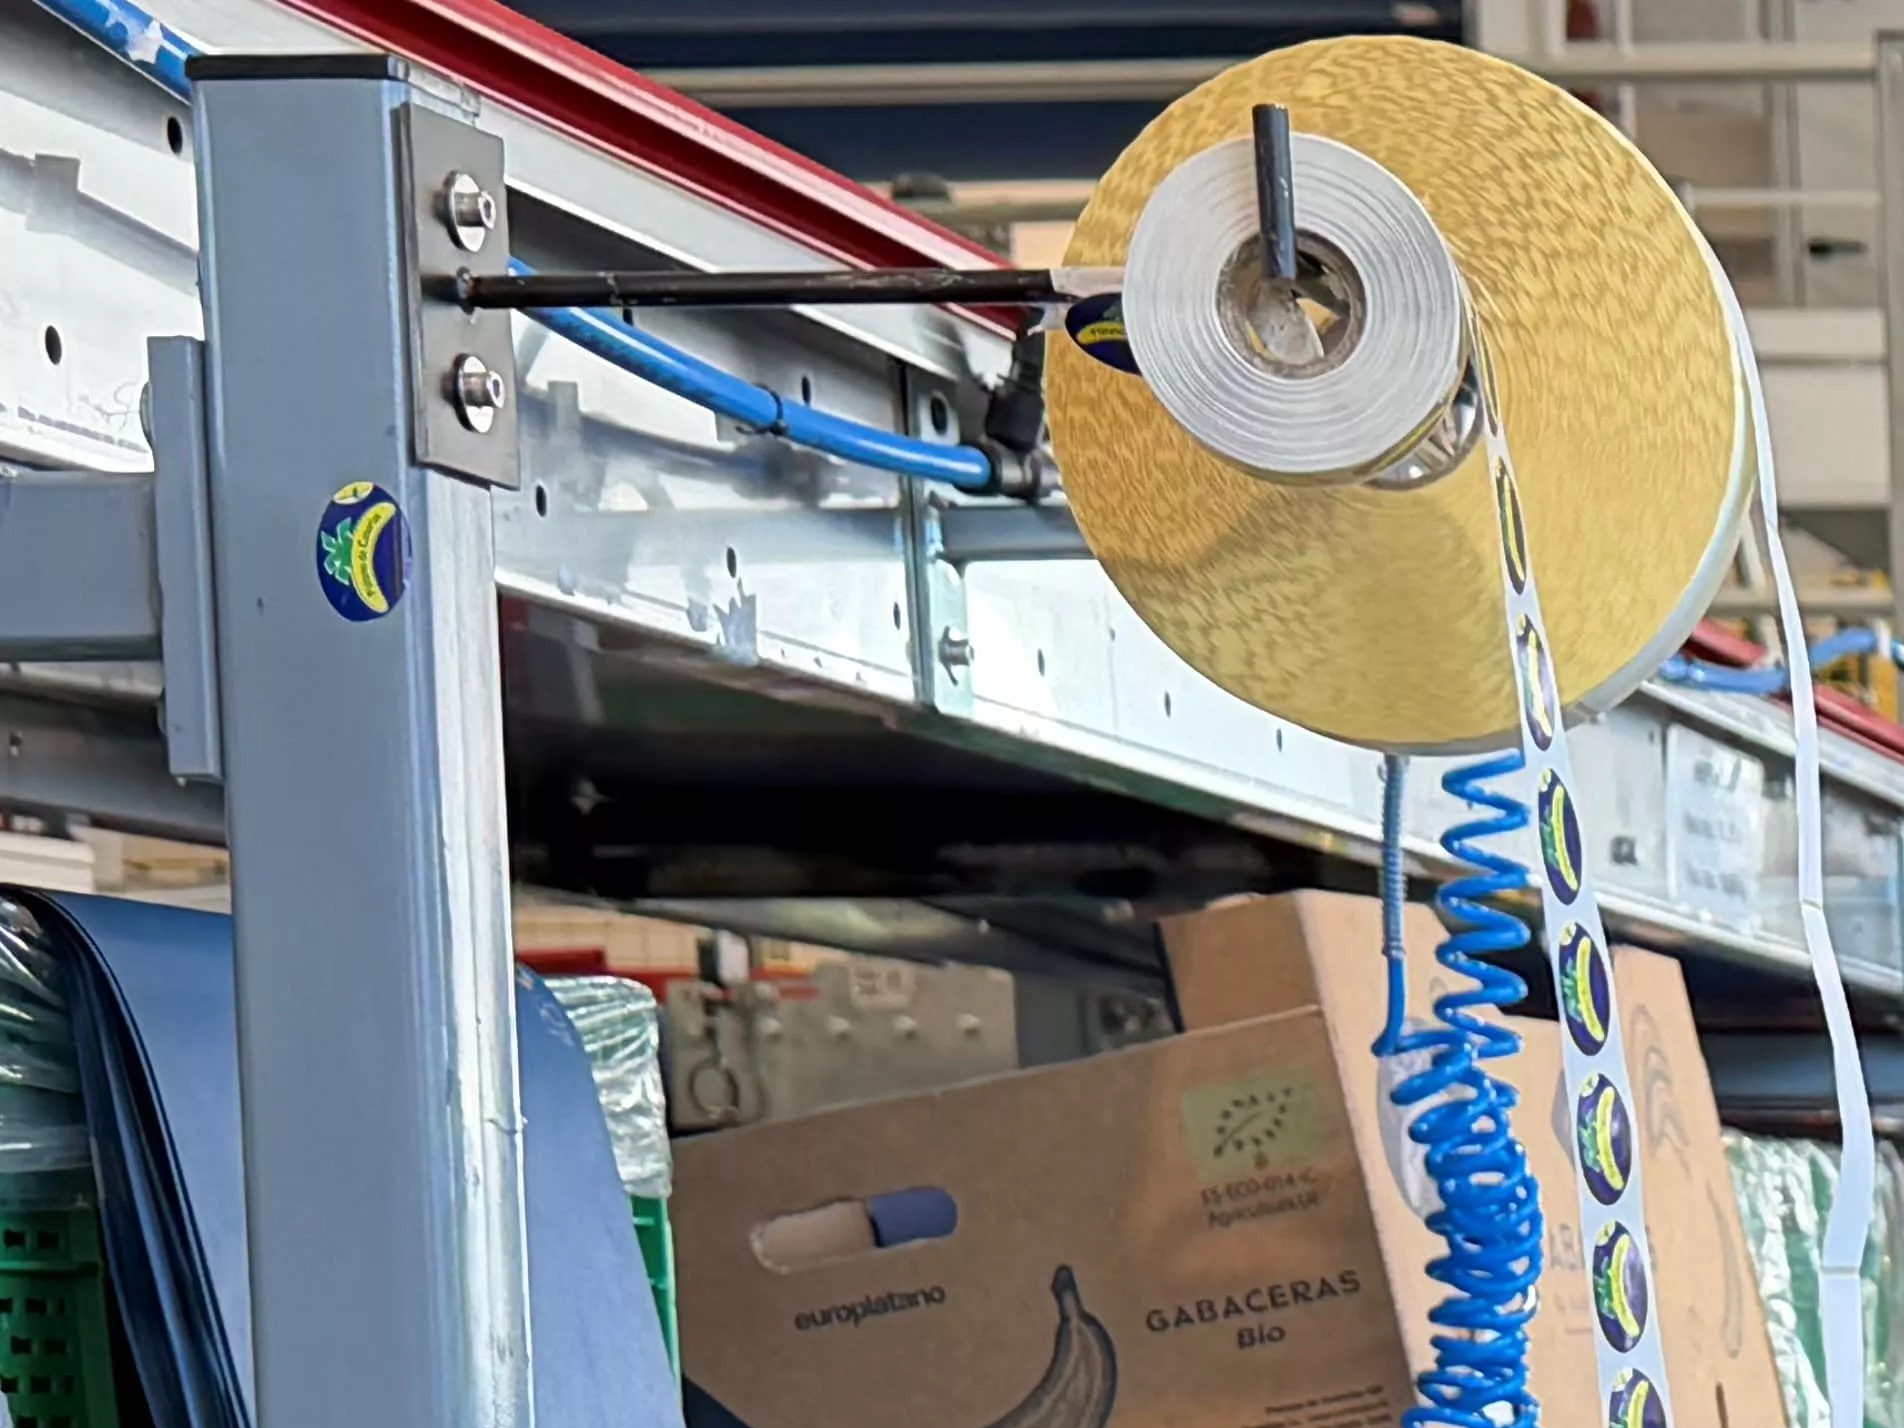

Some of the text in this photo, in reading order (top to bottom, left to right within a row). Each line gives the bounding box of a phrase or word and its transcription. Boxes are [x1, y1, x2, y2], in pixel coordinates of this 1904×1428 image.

[794, 1285, 947, 1329] europlatano
[1145, 1269, 1362, 1333] GABACERAS
[1236, 1323, 1287, 1350] Bio
